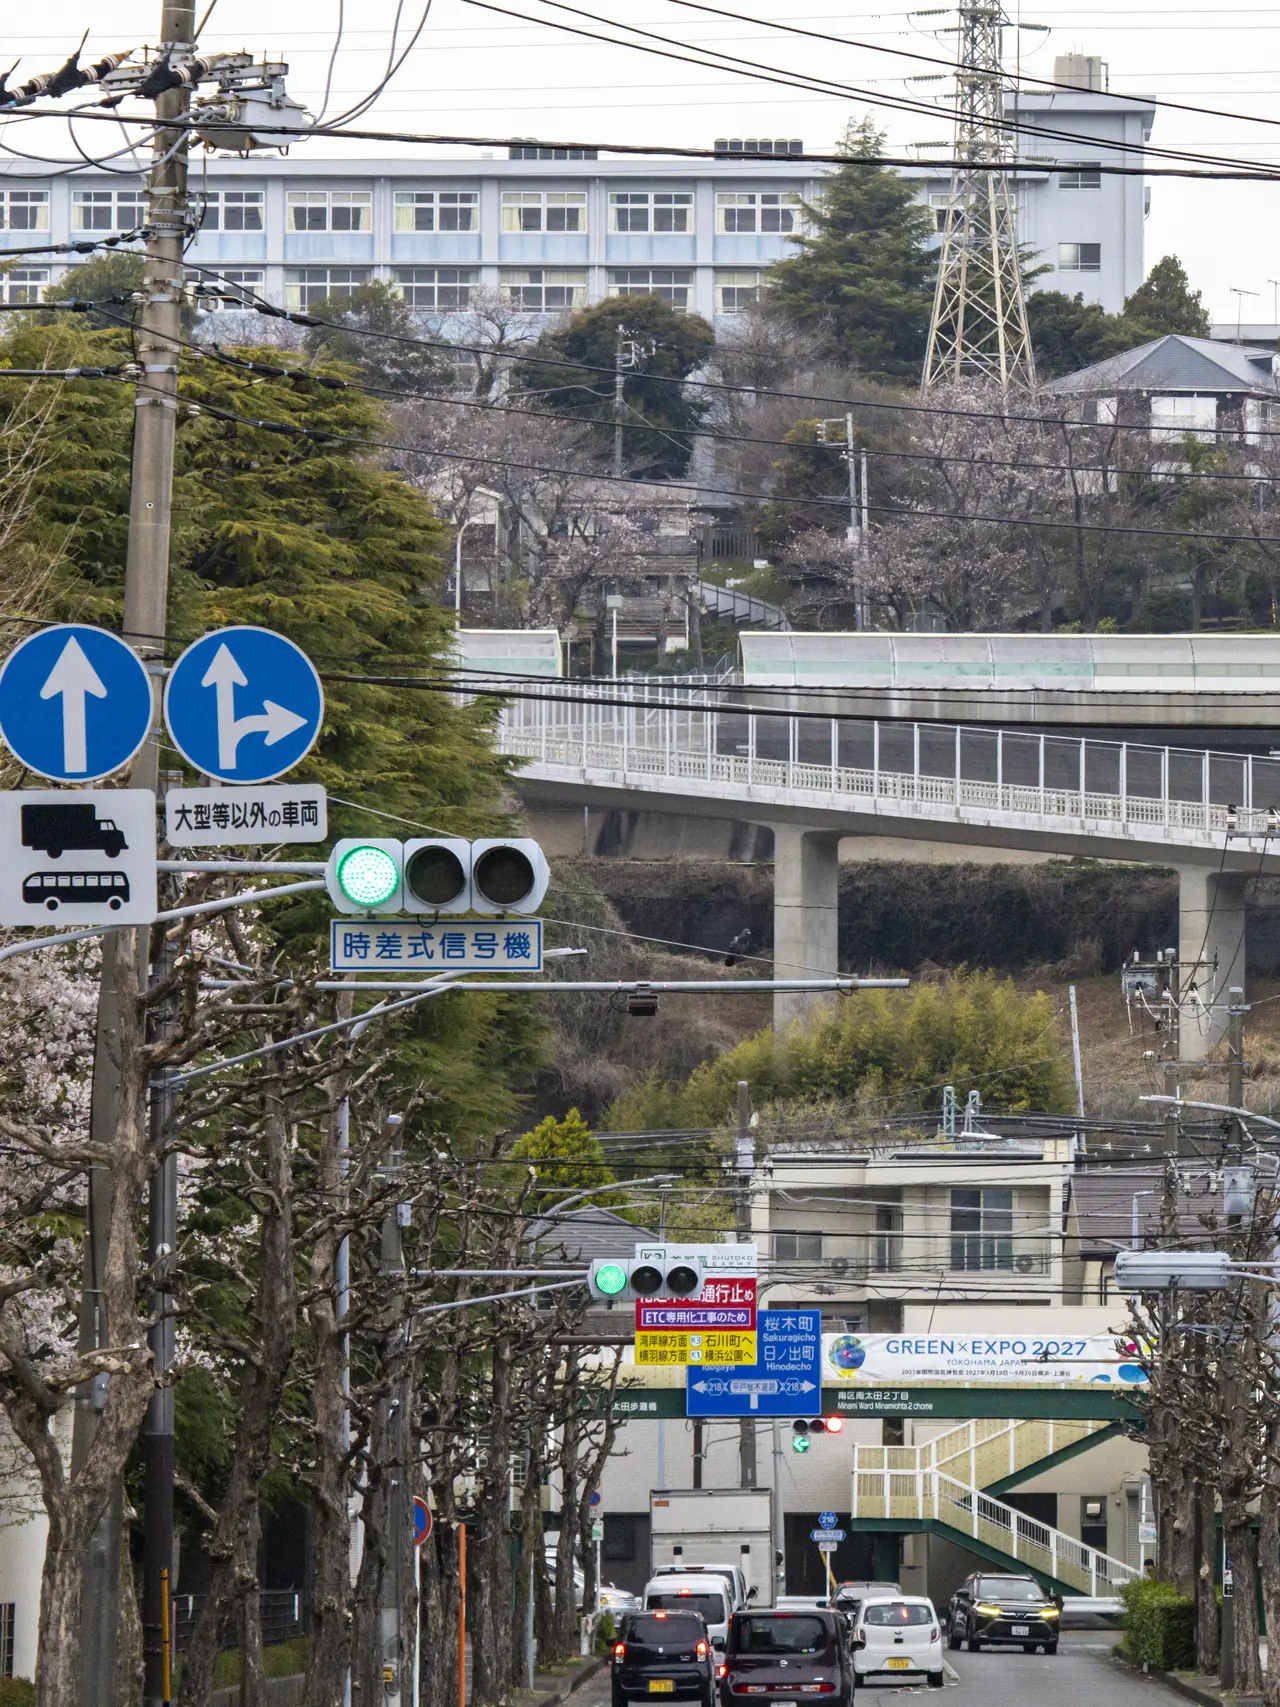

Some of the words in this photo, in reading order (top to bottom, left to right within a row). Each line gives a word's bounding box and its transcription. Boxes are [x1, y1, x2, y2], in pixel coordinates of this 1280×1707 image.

[174, 801, 319, 832] 大型等以外の車両
[343, 931, 532, 960] 時差式信号機
[645, 1312, 747, 1324] ETC専用化工事のため
[764, 1316, 814, 1332] 桜木町
[639, 1335, 688, 1348] 湾岸線方面
[705, 1335, 753, 1348] 石川町へ
[762, 1333, 816, 1343] Sakuragicho
[764, 1345, 815, 1361] 日ノ出町
[1031, 1341, 1087, 1356] 2027
[639, 1350, 688, 1362] 横羽線方面
[704, 1350, 753, 1363] 横浜公園へ
[766, 1362, 811, 1371] Hinodecho
[709, 1382, 723, 1392] 218
[785, 1382, 799, 1392] 218
[837, 1402, 858, 1410] Minami
[858, 1402, 873, 1410] Ward
[821, 1516, 835, 1524] 218
